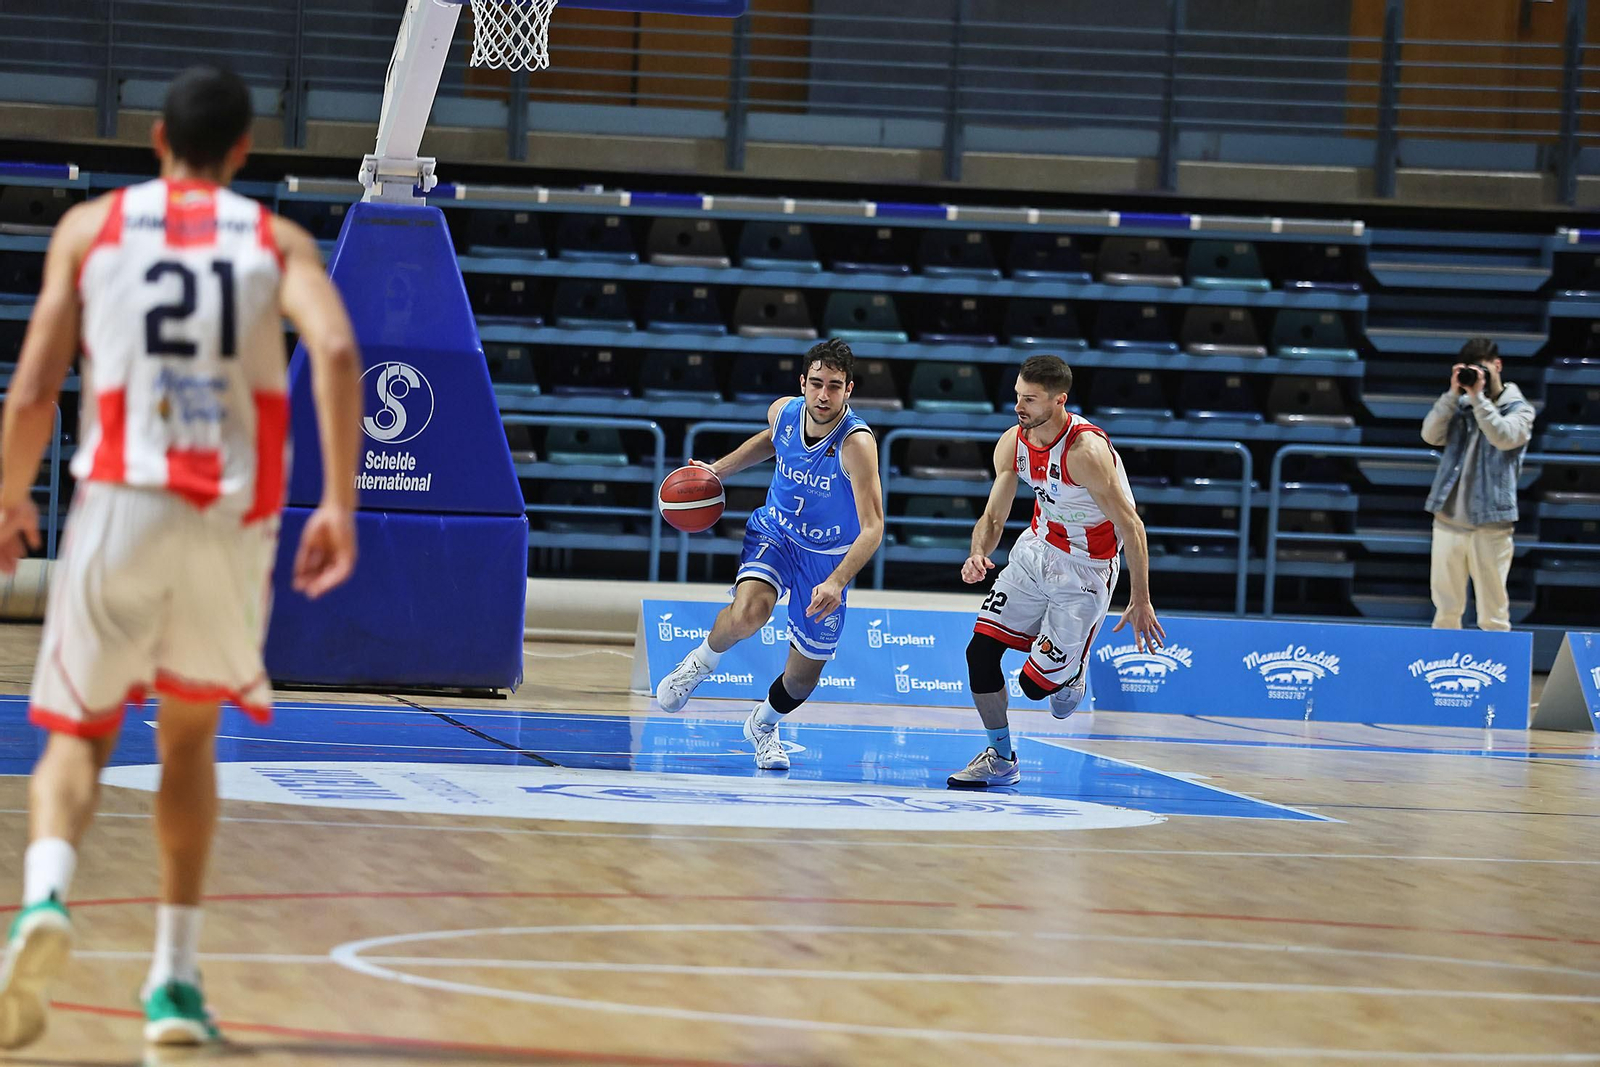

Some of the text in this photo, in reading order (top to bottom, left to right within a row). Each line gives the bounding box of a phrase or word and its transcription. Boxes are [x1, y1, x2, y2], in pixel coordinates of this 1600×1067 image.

[145, 259, 237, 358] 21
[365, 450, 416, 470] Schelde
[353, 472, 431, 491] nternational
[794, 495, 805, 517] 7
[755, 542, 770, 559] 7
[981, 590, 1008, 615] 22
[674, 626, 711, 640] Expla
[883, 633, 936, 647] Explant
[1243, 644, 1293, 670] Manuel
[1293, 646, 1340, 675] Castillo
[1408, 652, 1460, 677] Manuel
[1459, 653, 1507, 683] Castillo
[818, 675, 856, 687] plant
[910, 678, 964, 692] Explant
